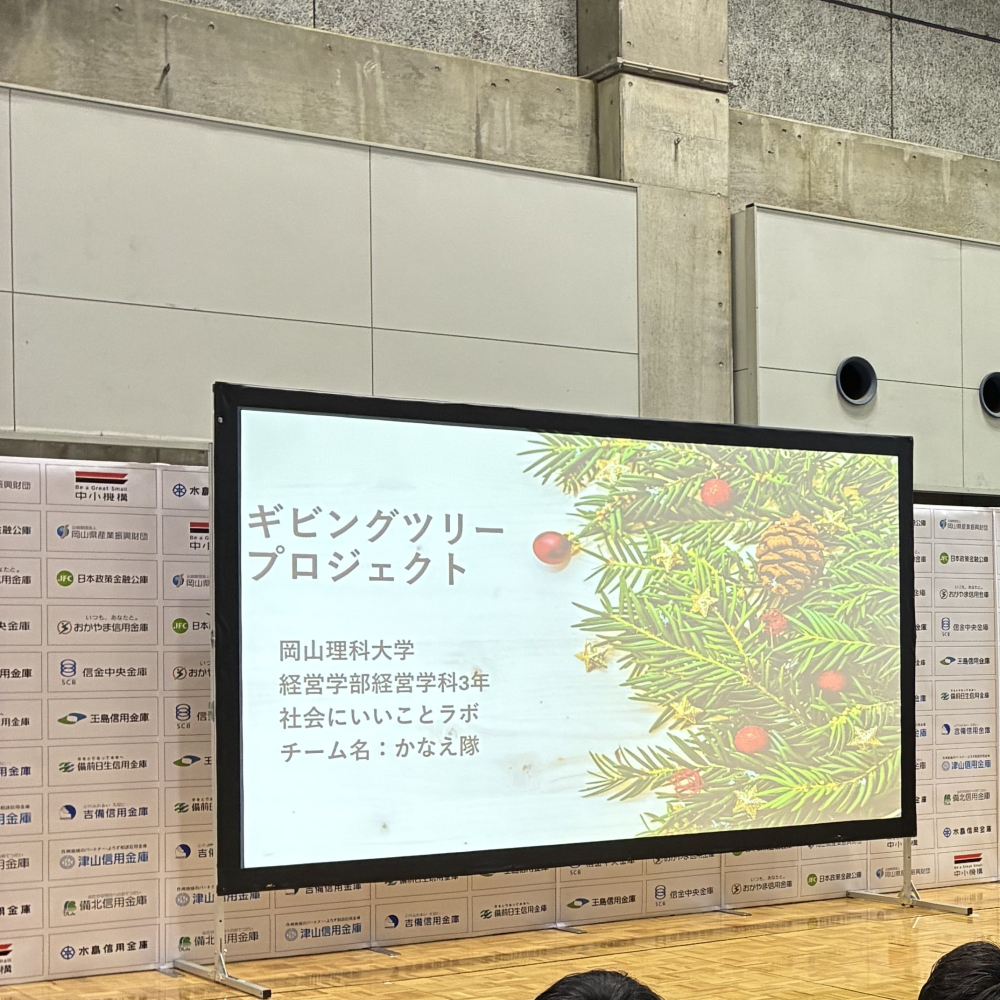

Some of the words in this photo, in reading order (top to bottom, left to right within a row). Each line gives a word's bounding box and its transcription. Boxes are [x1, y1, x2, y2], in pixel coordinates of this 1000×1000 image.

[75, 491, 128, 502] 中小機構
[248, 503, 504, 545] ギビングツリー
[71, 530, 148, 540] 岡山県産業振興財団
[248, 545, 466, 585] プロジェクト
[0, 575, 32, 585] 用金庫
[77, 574, 148, 584] 日本政策金融公庫
[74, 623, 148, 632] おかやま信用金庫
[279, 639, 415, 662] 岡山理科大学
[82, 667, 147, 677] 信金中央金庫
[278, 671, 491, 696] 経営学部経営学科3年
[279, 702, 479, 730] 社会にいいことラボ
[280, 734, 480, 763] チーム名：かなえ隊
[77, 760, 148, 771] 備前日生信用金庫
[84, 807, 149, 819] 吉備信用金庫
[78, 851, 149, 867] 津山信用金庫
[669, 886, 714, 899] 信金中央金庫
[742, 880, 793, 892] おかやま信用金庫
[79, 894, 148, 911] 備北信用金庫
[405, 914, 460, 928] 吉備信用金庫
[300, 922, 362, 939] 津山信用金庫
[78, 940, 149, 956] 水島信用金庫
